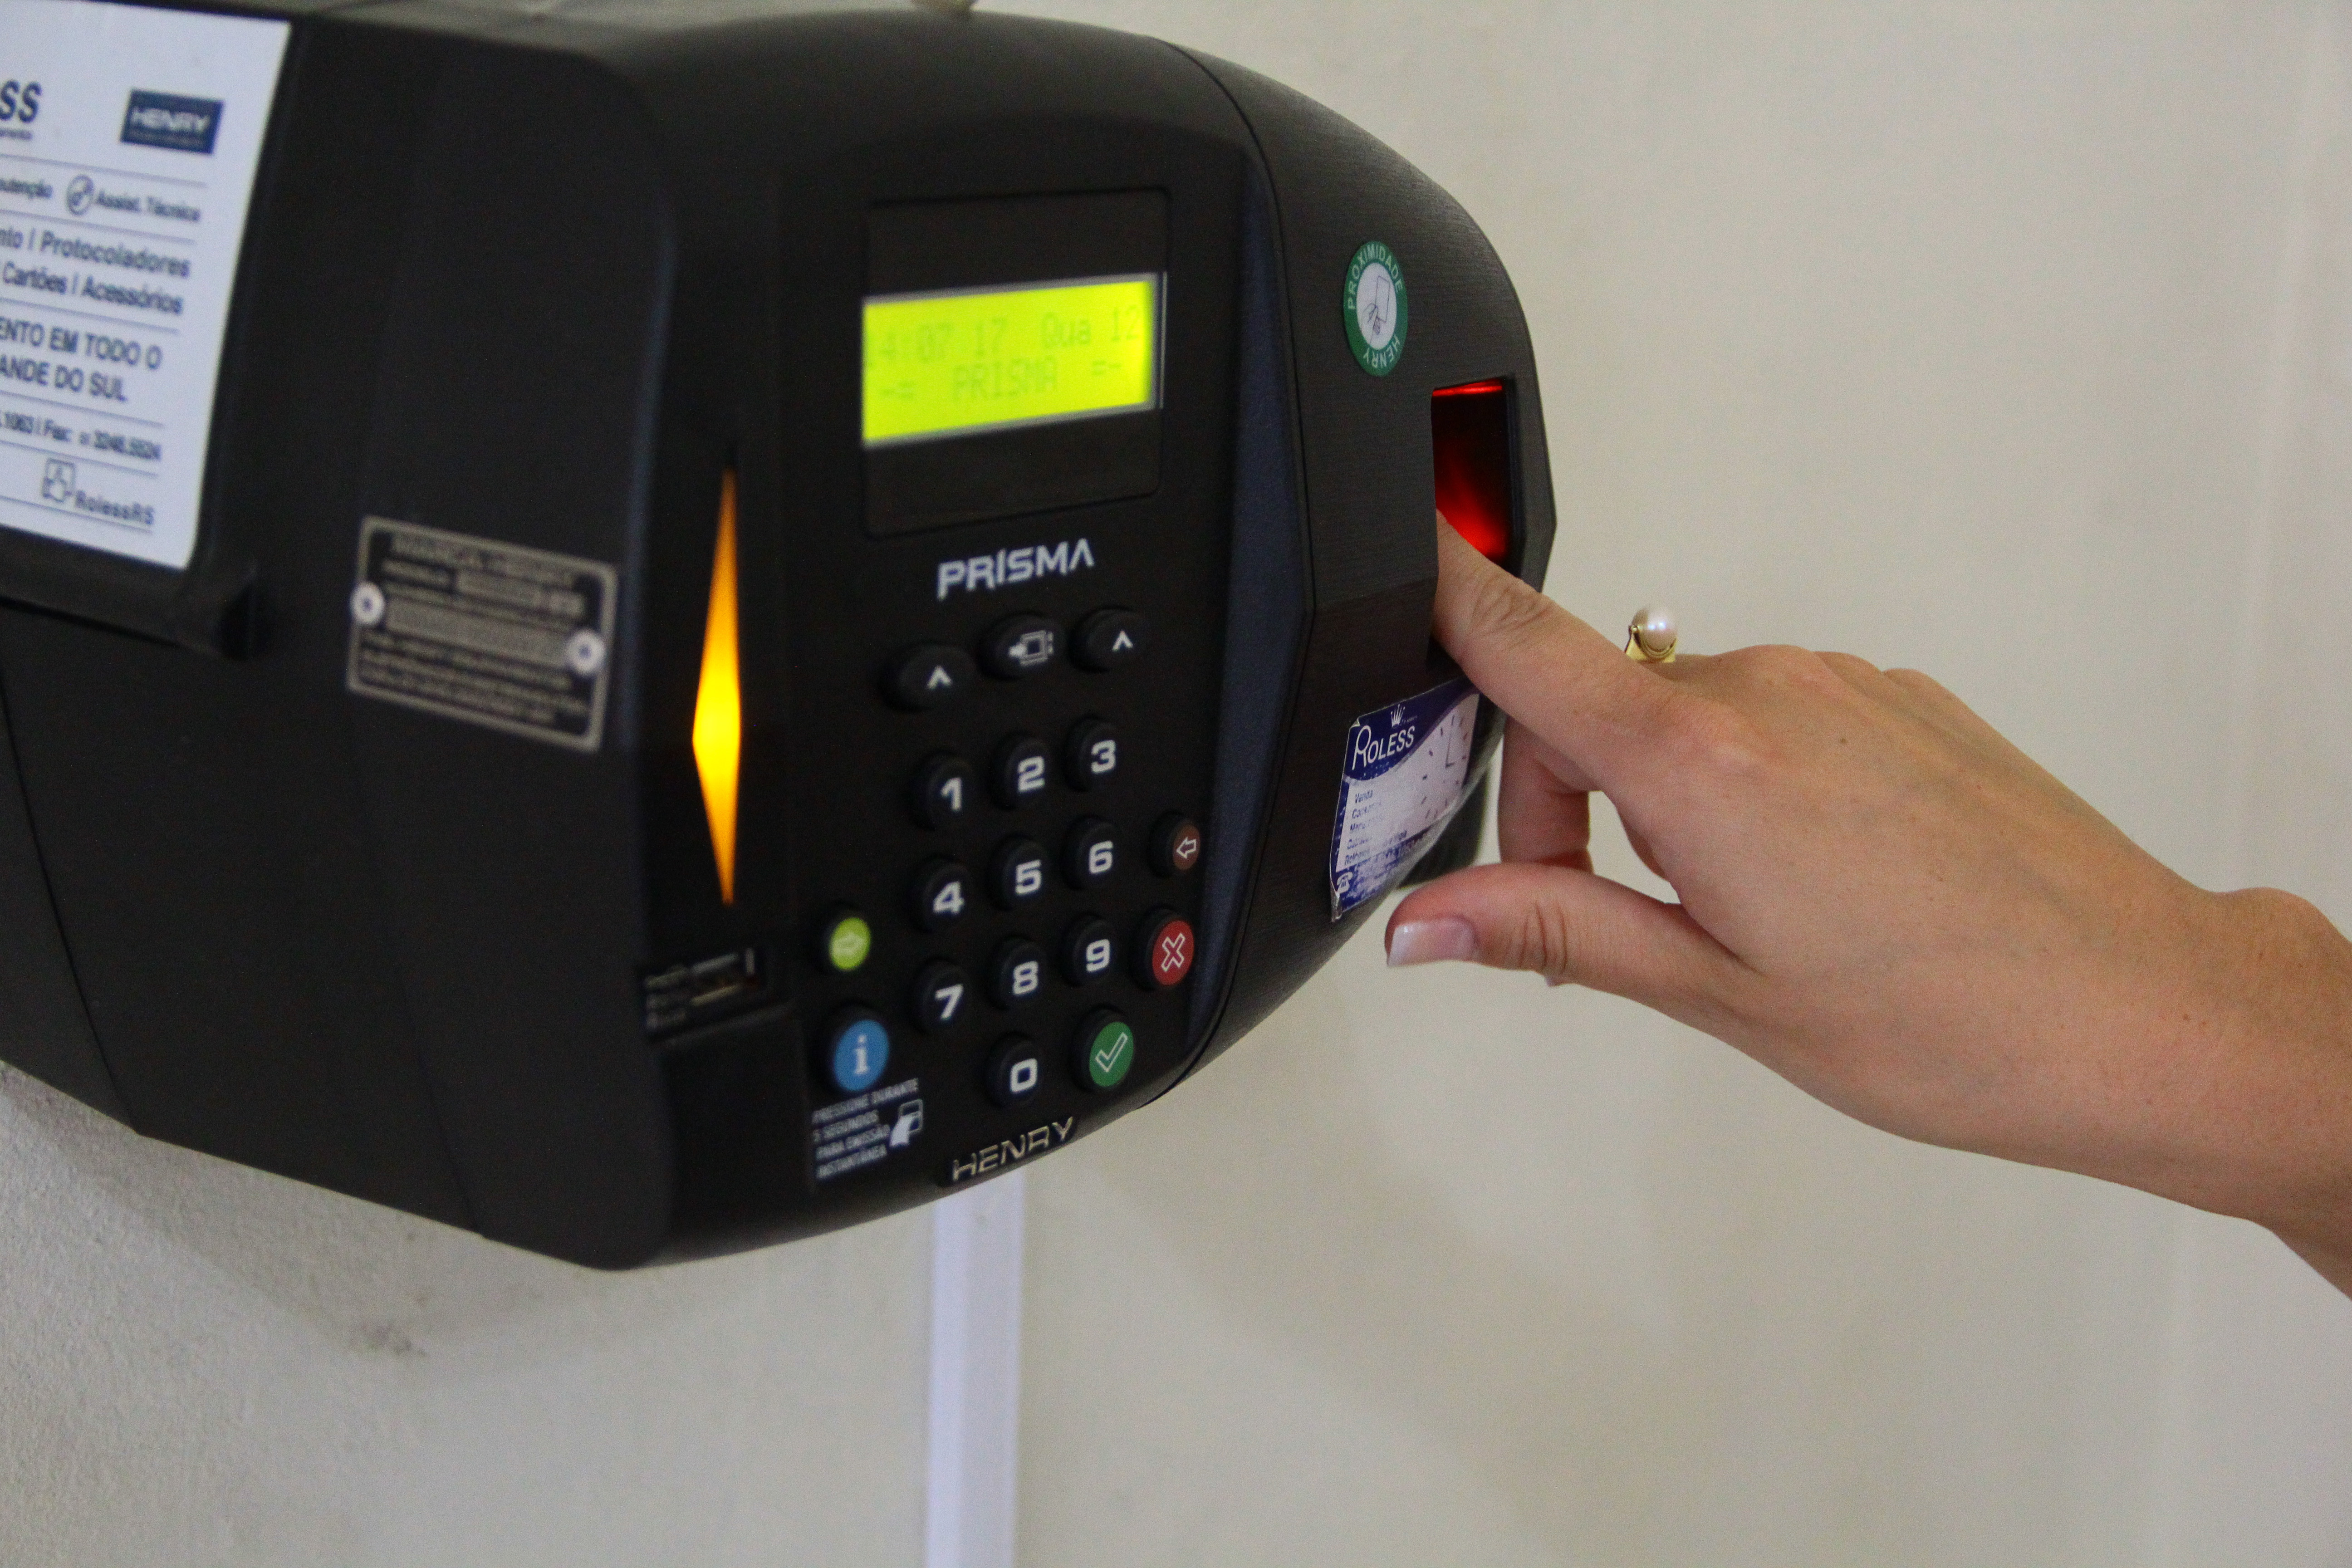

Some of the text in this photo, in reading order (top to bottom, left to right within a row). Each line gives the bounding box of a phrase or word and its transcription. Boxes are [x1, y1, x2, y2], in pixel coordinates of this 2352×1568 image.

[41, 229, 191, 279] Protocoladores
[3, 260, 68, 294] Cartões
[83, 276, 183, 315] Acessórios
[50, 327, 77, 353] EM
[84, 332, 141, 366] TODO
[146, 345, 162, 369] O
[54, 365, 84, 392] DO
[90, 371, 127, 402] SUL
[953, 355, 1058, 401] PRISMA
[937, 538, 1095, 602] PRISMA
[1351, 725, 1415, 770] ROLESS
[941, 740, 1116, 811] 1 2 3
[933, 840, 1113, 914] 4 5 6
[935, 939, 1110, 1019] 7 8 9
[952, 1116, 1073, 1181] HENRY
